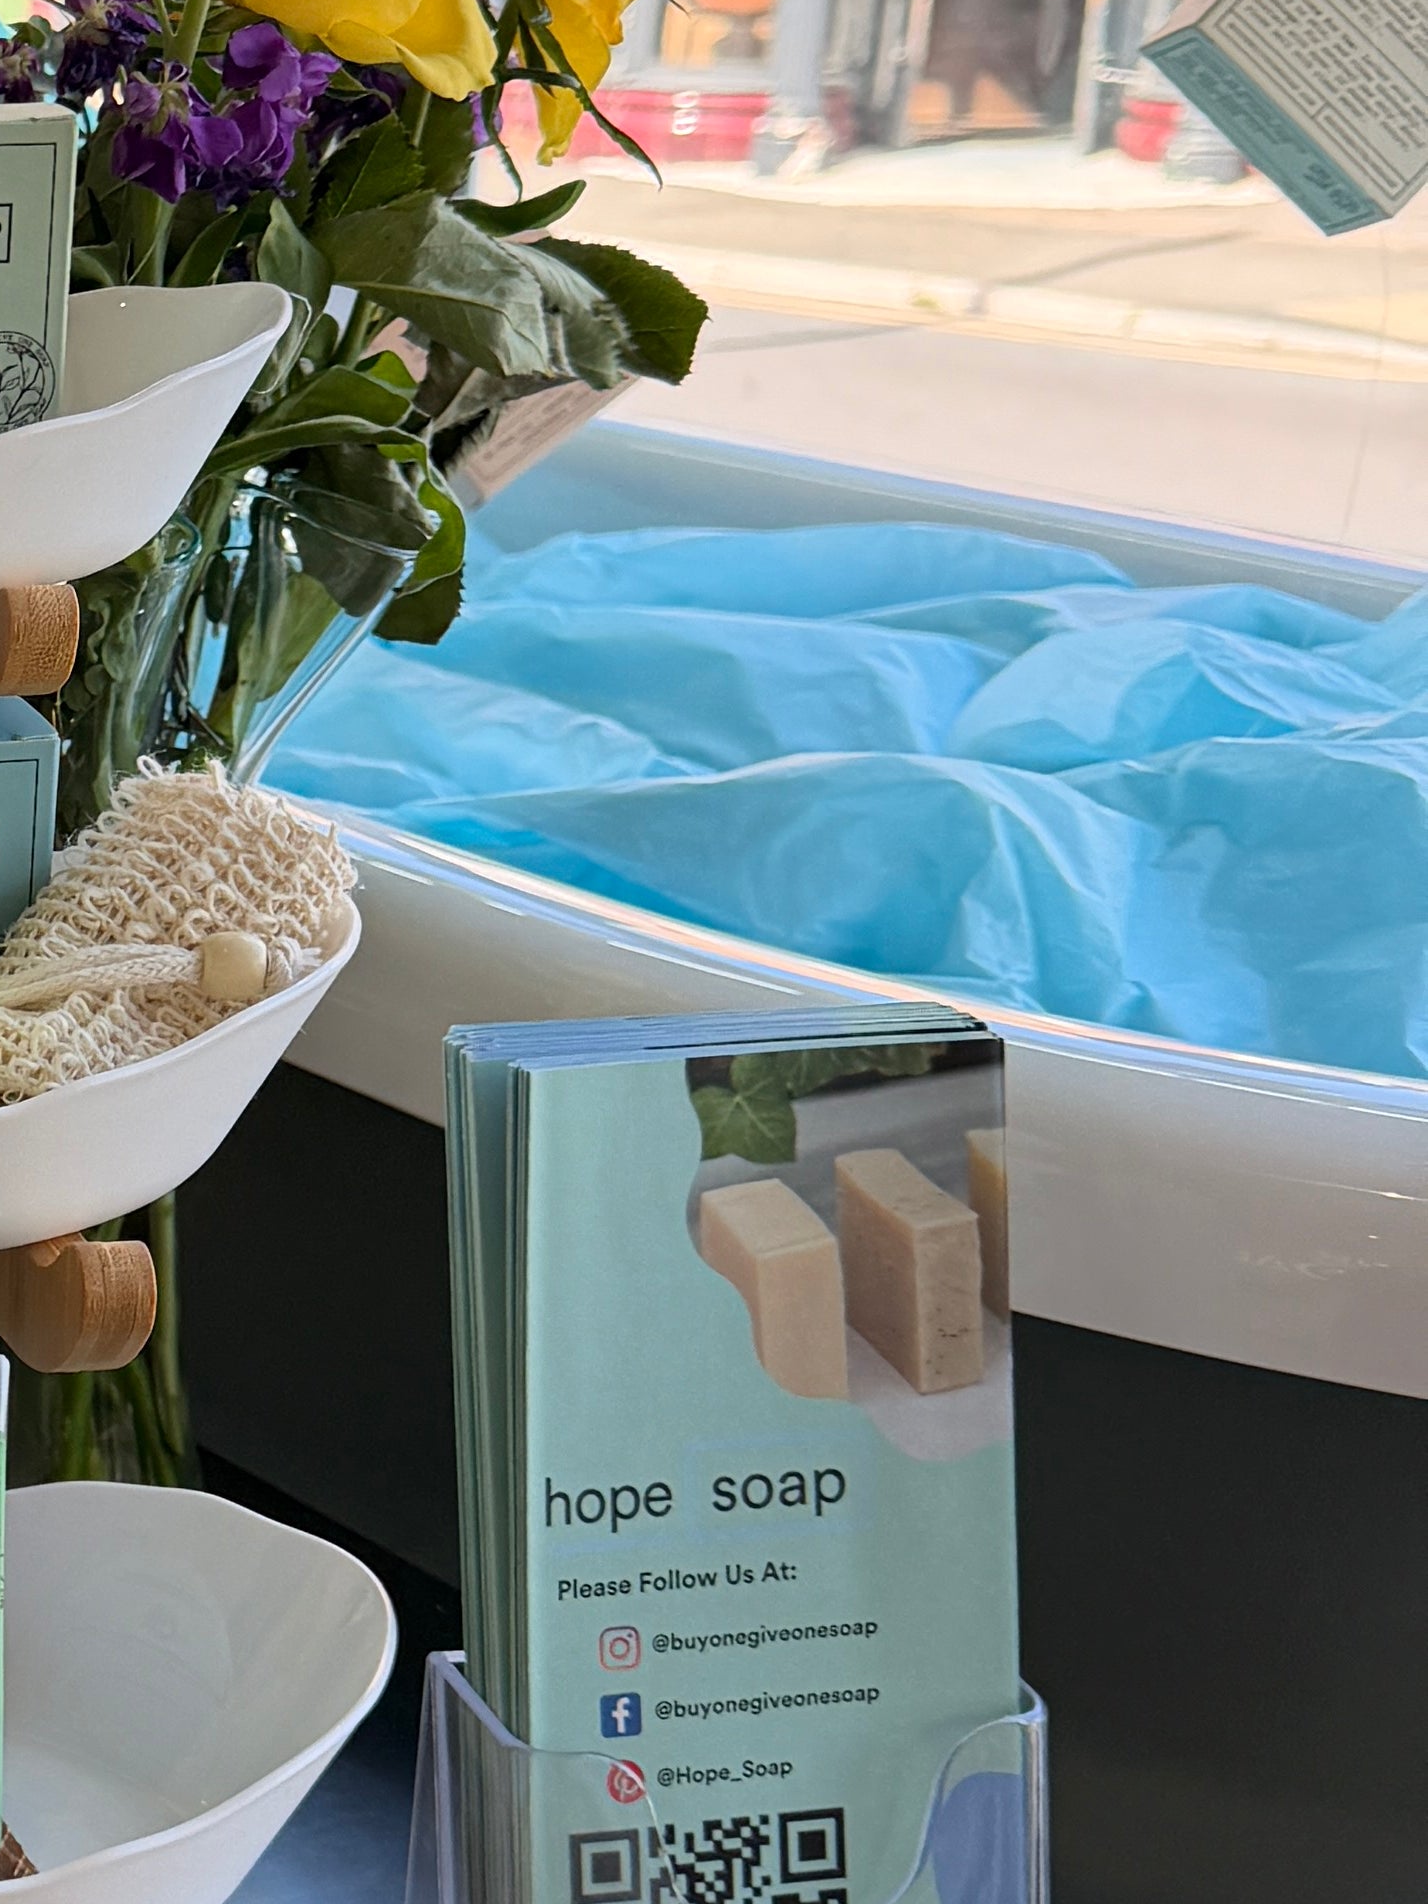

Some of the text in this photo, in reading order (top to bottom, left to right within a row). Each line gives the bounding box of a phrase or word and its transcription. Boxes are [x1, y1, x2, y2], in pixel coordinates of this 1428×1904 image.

[544, 1465, 847, 1533] hope soap
[557, 1558, 799, 1602] Please Follow Us At:
[652, 1616, 879, 1655] @buyonegiveonesoap
[654, 1683, 881, 1722] @buyonegiveonesoap
[657, 1757, 794, 1788] @Hope_Soap
